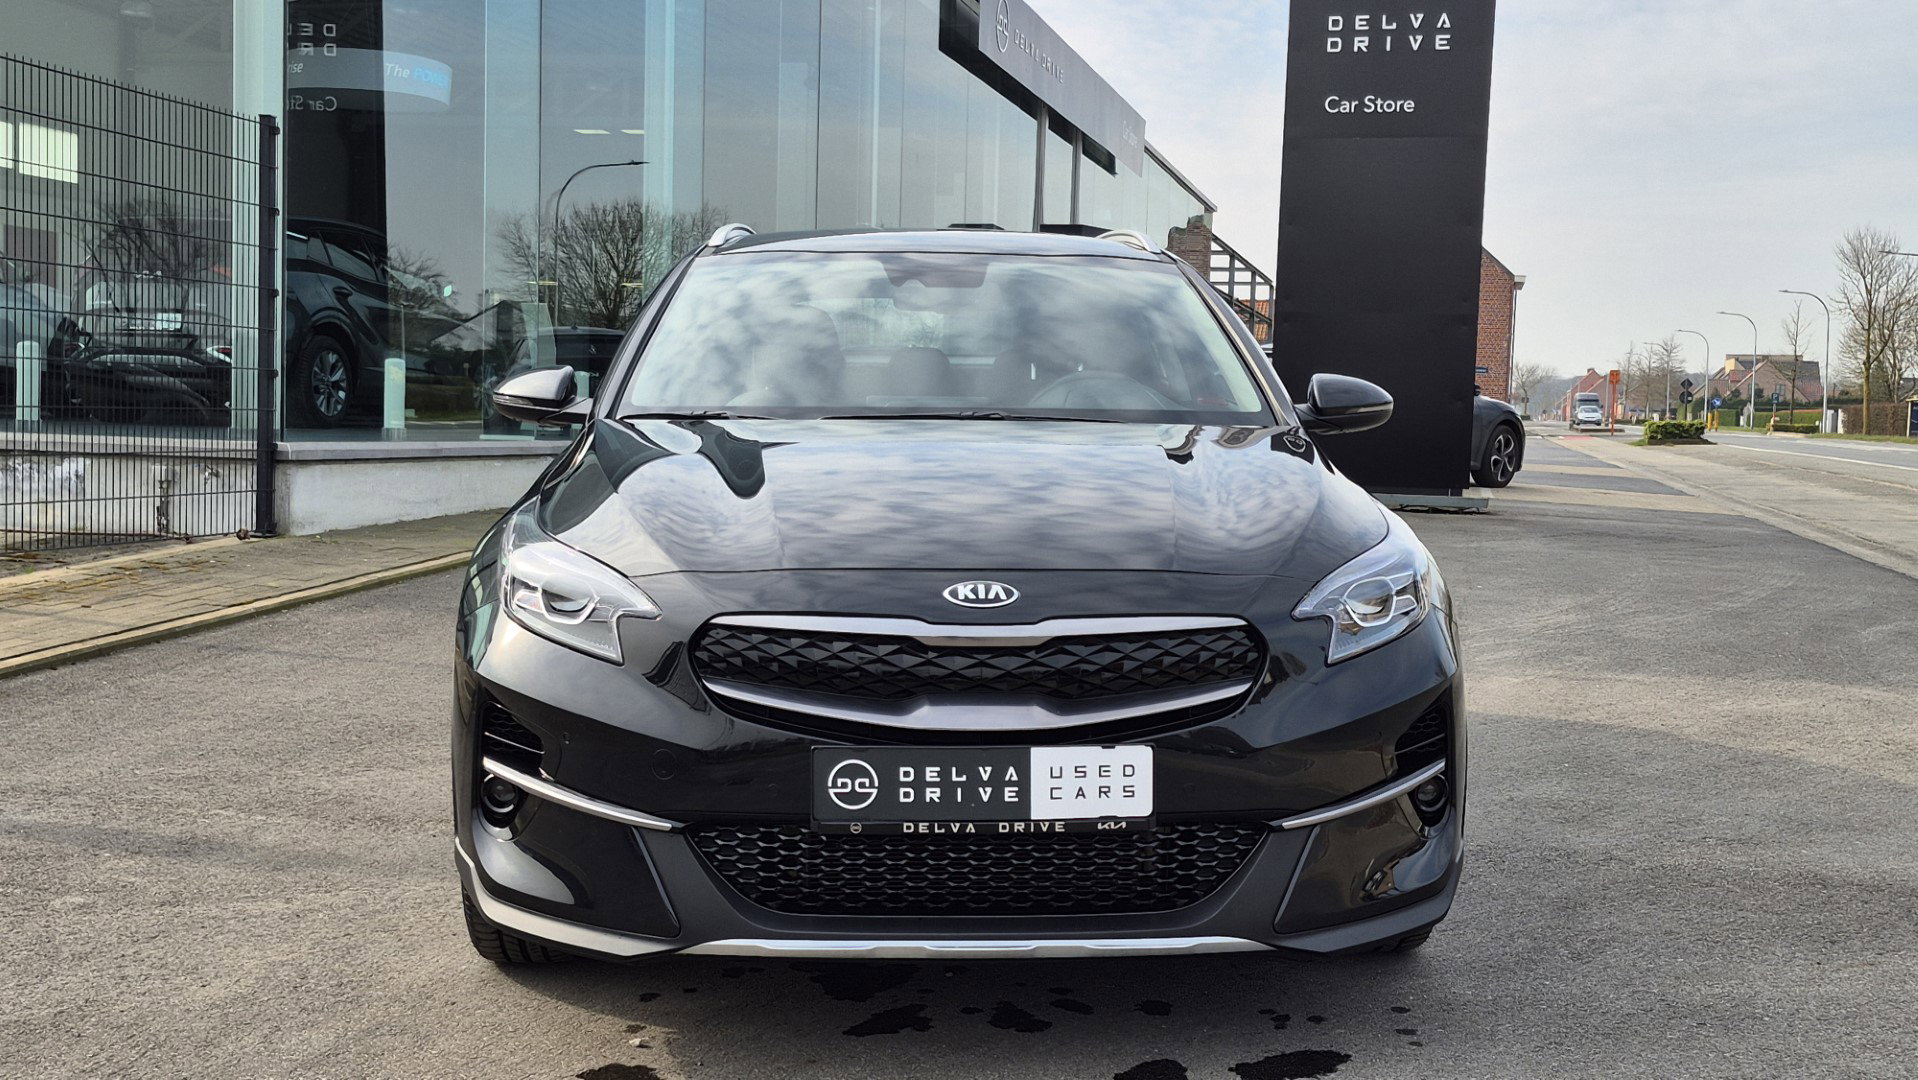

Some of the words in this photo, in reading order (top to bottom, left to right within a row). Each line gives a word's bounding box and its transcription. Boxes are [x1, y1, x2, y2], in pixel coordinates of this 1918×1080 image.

[1327, 12, 1452, 31] DELVA
[1326, 34, 1452, 53] DRIVE
[385, 62, 411, 79] The
[1324, 95, 1359, 113] Car
[1363, 95, 1415, 113] Store
[957, 583, 1008, 600] KIA
[899, 765, 1019, 782] DELVA
[1049, 763, 1136, 780] USED
[899, 786, 1019, 803] DRIVE
[1049, 784, 1136, 801] CARS
[902, 821, 976, 834] DELVA
[998, 821, 1066, 834] DRIVE
